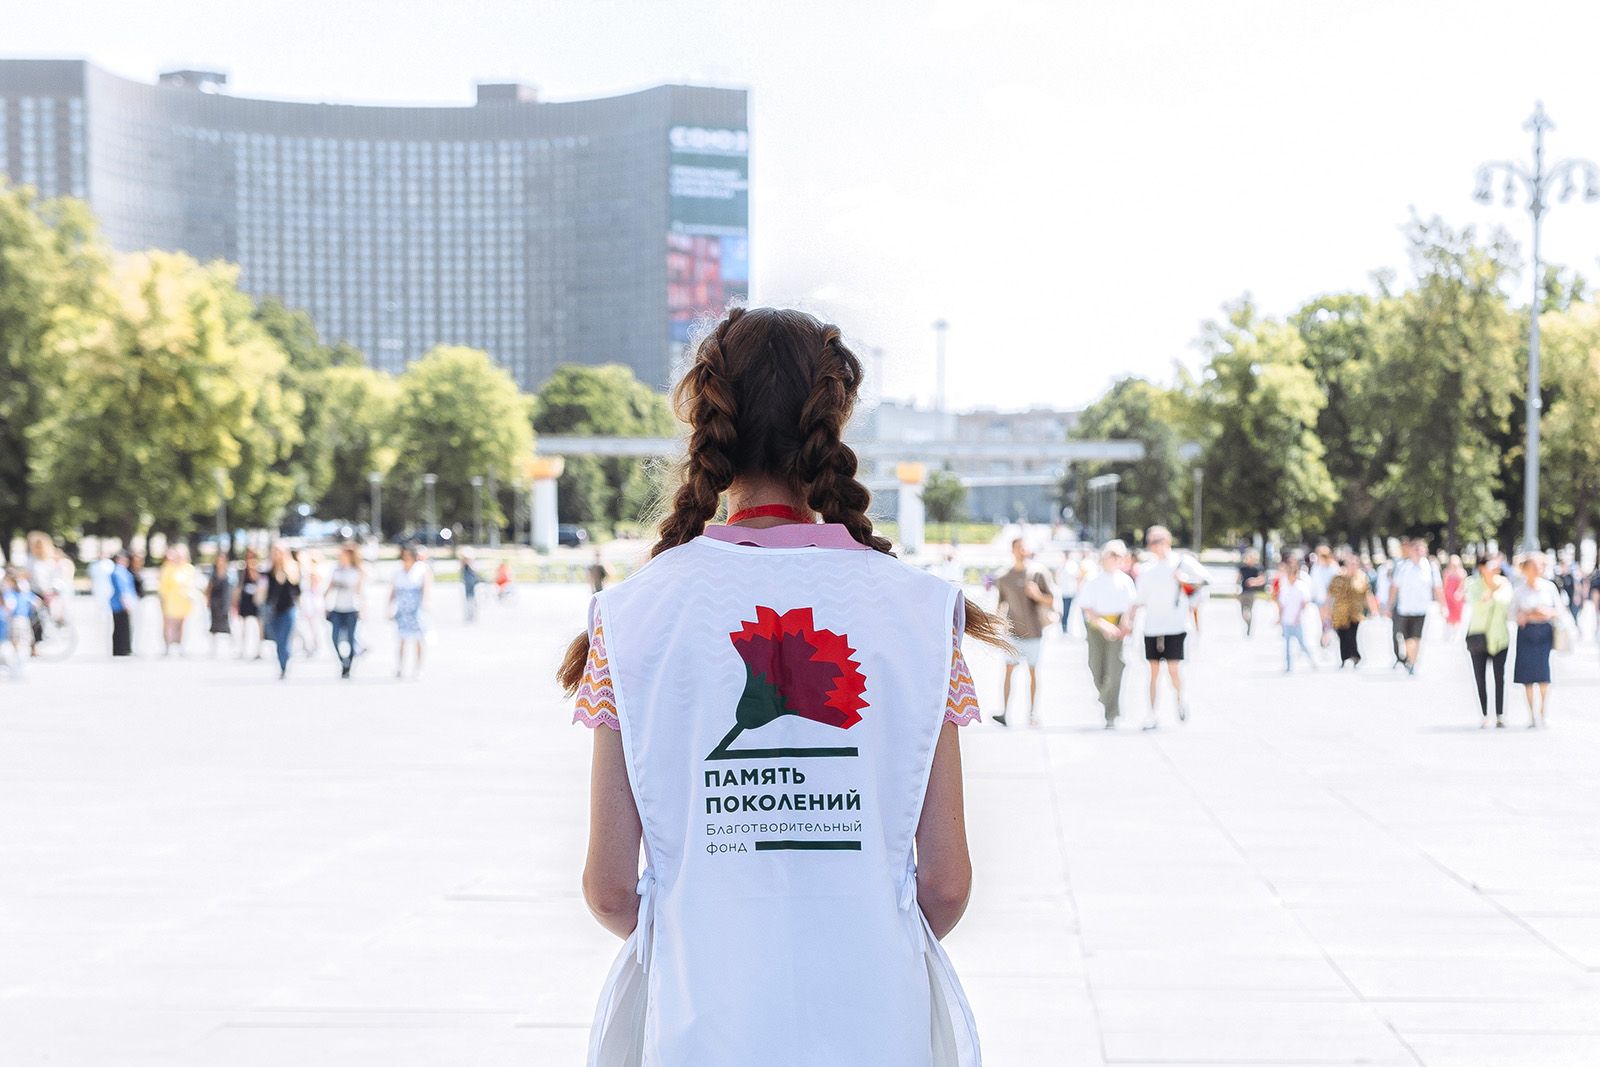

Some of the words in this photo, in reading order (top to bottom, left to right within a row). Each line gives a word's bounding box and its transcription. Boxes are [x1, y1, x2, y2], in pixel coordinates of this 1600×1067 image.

[705, 768, 806, 787] ПАМЯТЬ
[706, 789, 861, 814] ПОКОЛЕНИЙ
[706, 820, 862, 836] Благотворительный
[706, 842, 748, 855] фонд
